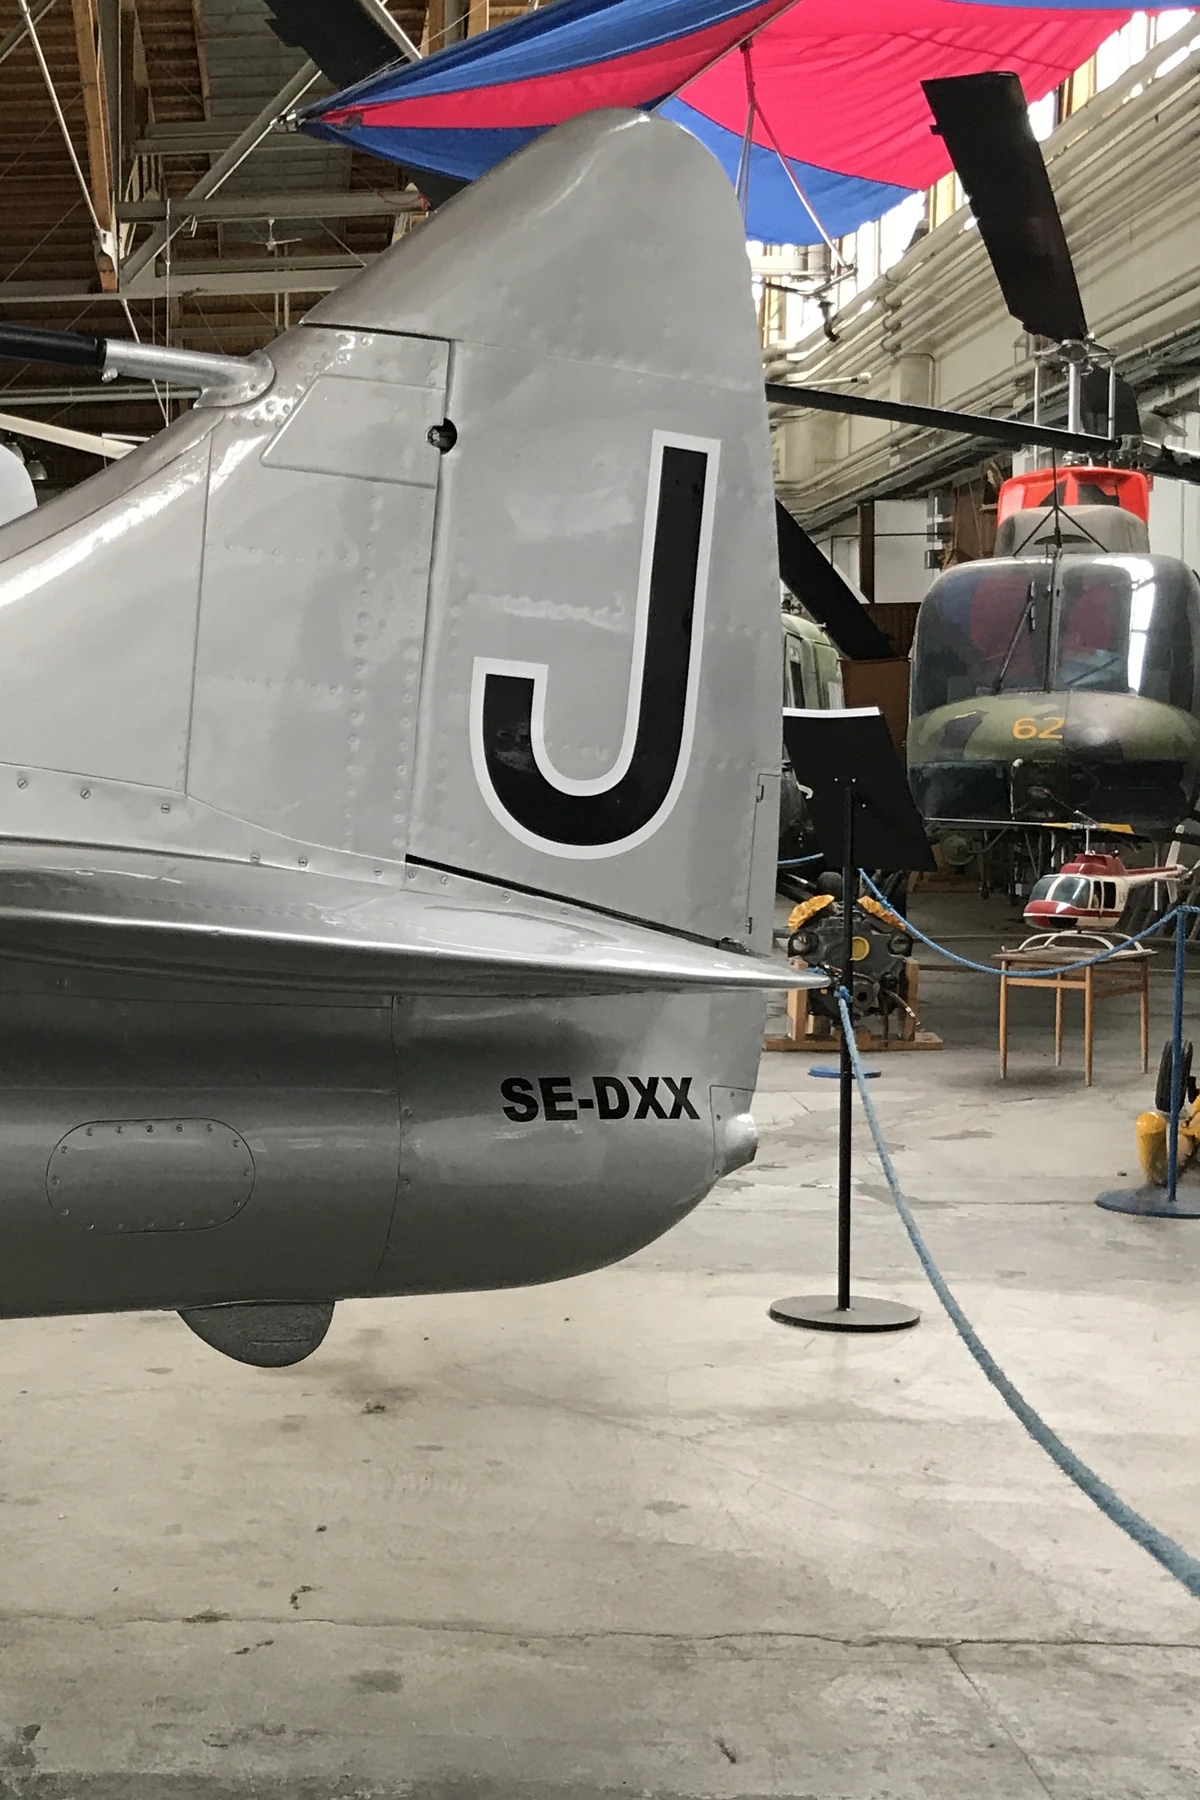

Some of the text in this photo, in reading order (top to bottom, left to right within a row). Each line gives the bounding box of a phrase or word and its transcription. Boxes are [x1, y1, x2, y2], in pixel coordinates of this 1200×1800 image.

[470, 429, 720, 860] J
[1012, 716, 1064, 740] 62
[500, 1075, 701, 1123] SE-DXX
